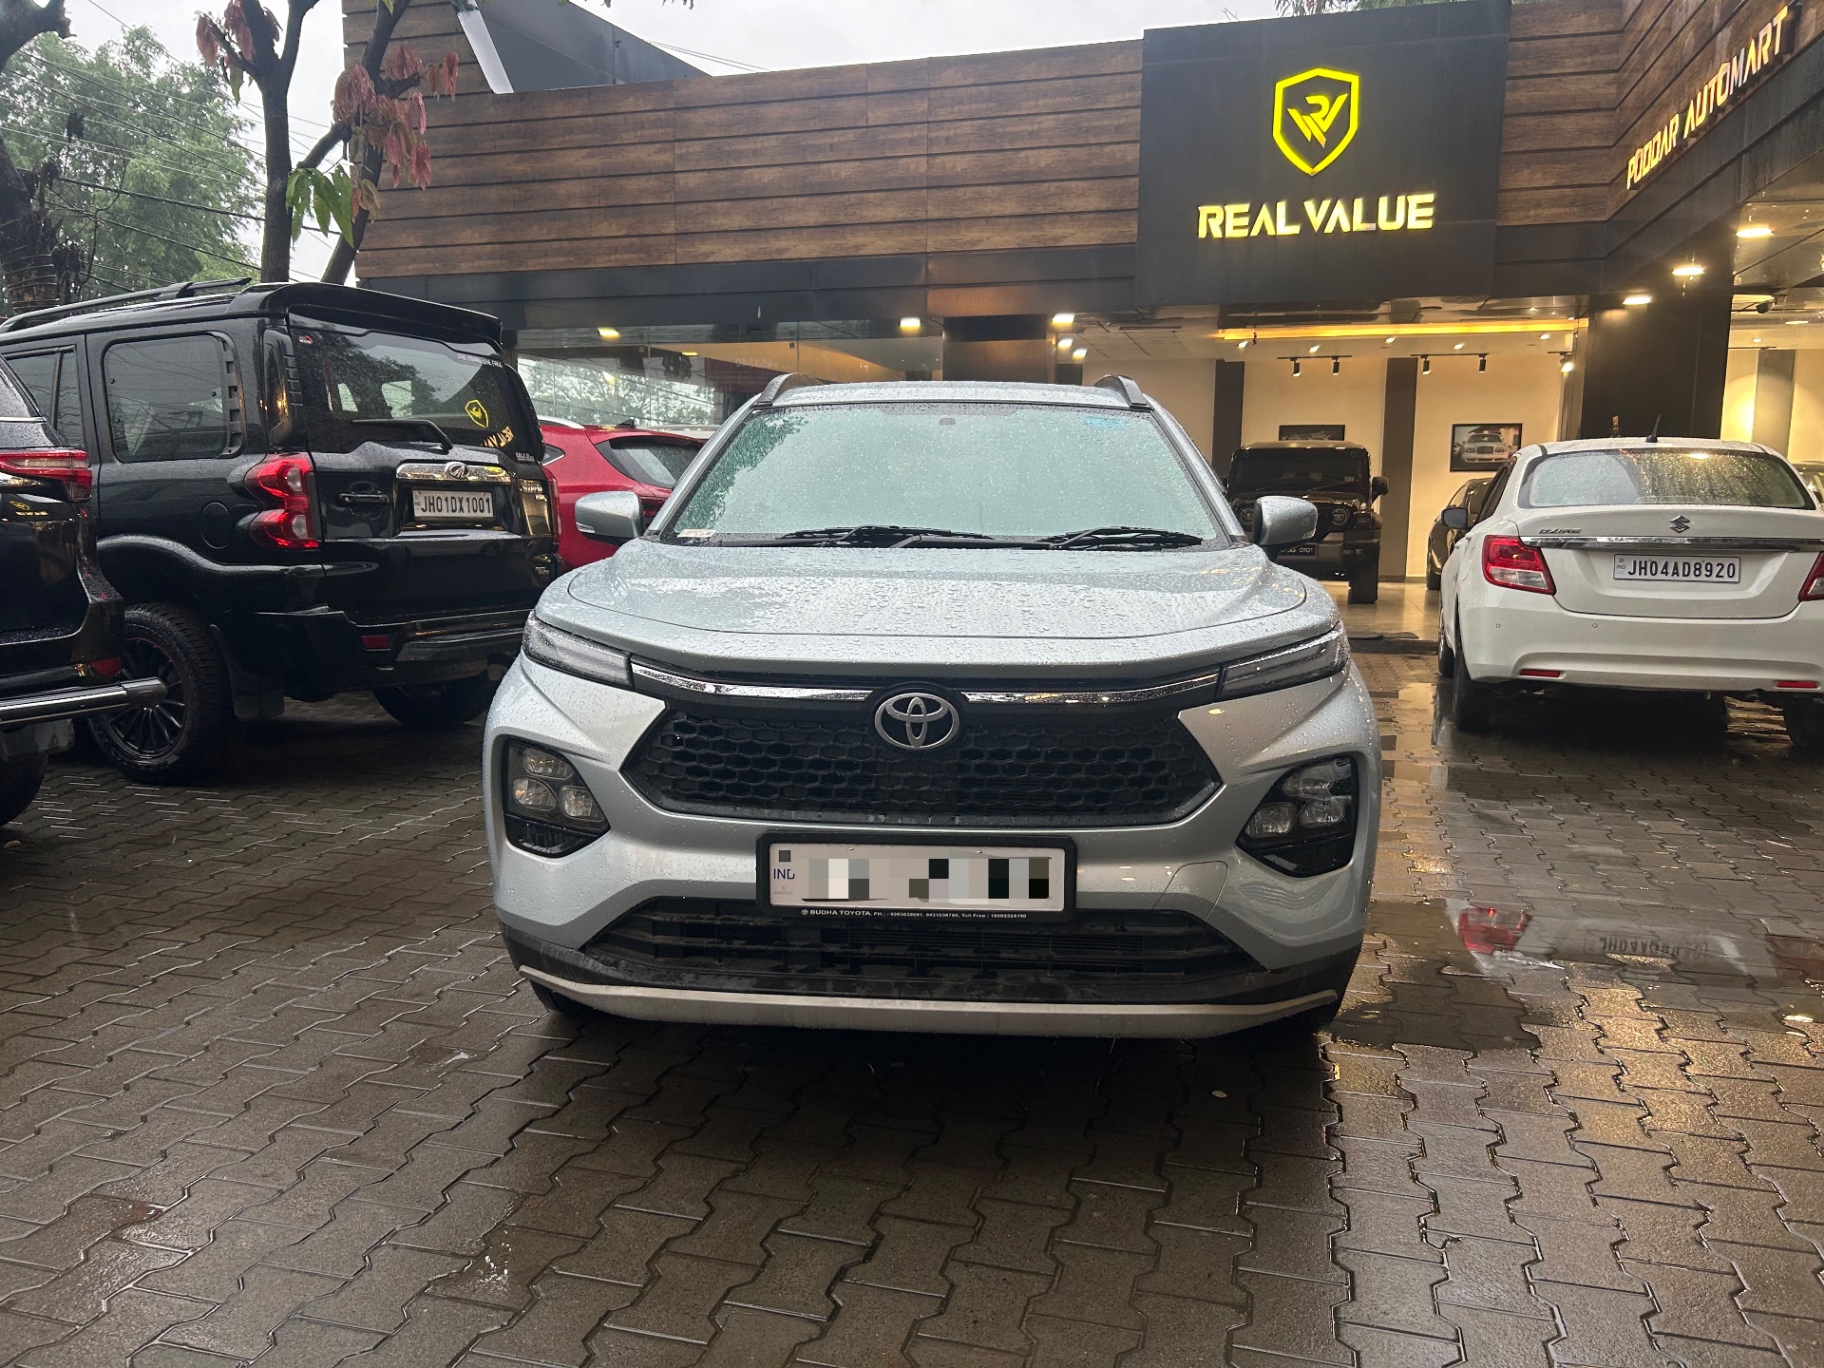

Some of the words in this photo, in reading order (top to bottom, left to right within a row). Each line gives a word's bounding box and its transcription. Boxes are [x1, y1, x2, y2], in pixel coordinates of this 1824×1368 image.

[1626, 113, 1680, 190] PODDAR
[1683, 5, 1788, 139] AUTOMART
[1198, 200, 1301, 239] REAL
[1303, 193, 1435, 234] VALUE
[421, 495, 491, 514] JH01DX1001
[1627, 559, 1736, 579] JH04AD8920
